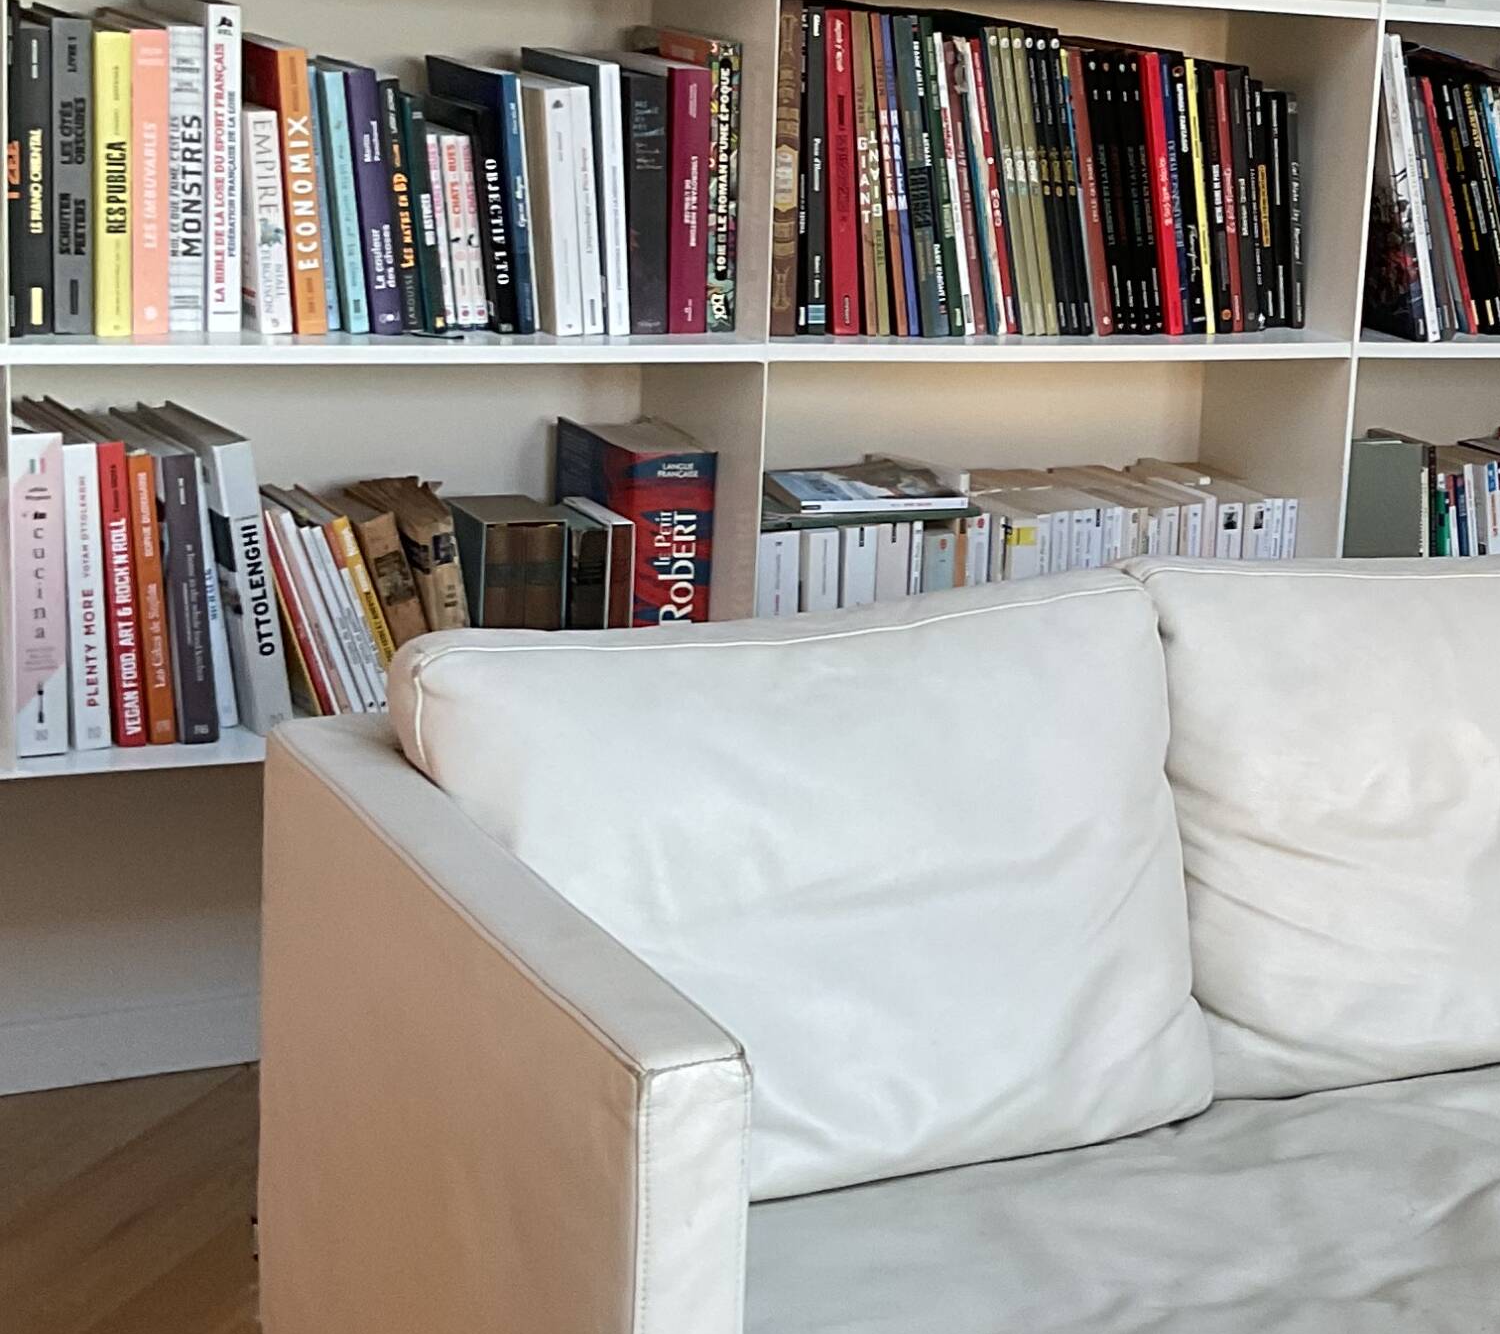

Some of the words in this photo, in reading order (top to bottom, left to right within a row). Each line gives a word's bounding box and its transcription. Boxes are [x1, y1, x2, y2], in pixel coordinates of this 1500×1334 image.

[716, 68, 731, 121] ÉPOQUE
[214, 112, 225, 152] SPORT
[717, 124, 730, 163] D'UNE
[106, 141, 127, 205] PUBLICA
[214, 155, 225, 173] DU
[253, 120, 278, 214] EMPIRE
[880, 109, 898, 211] HARLEM
[182, 116, 201, 257] MONSTRES
[214, 176, 225, 208] LOSE
[287, 116, 319, 271] ECONOMIX
[392, 174, 408, 192] BD
[717, 167, 729, 214] ROMAN
[857, 137, 872, 224] GIANT
[106, 206, 127, 233] RES
[214, 211, 225, 227] LA
[485, 158, 505, 244] OBJECTIF
[214, 230, 225, 246] DE
[382, 224, 394, 265] choses
[717, 217, 728, 232] LE
[214, 248, 225, 284] BIBLE
[371, 229, 384, 272] couleur
[214, 286, 226, 303] LA
[375, 273, 386, 289] La
[384, 267, 396, 288] des
[404, 274, 417, 325] LAROUSSE
[114, 567, 132, 604] ROCK
[241, 524, 275, 656] OTTOLENGHI
[82, 589, 96, 636] MORE
[117, 607, 132, 617] &
[118, 621, 135, 647] ART
[84, 643, 99, 707] PLENTY
[123, 690, 142, 736] VEGAN
